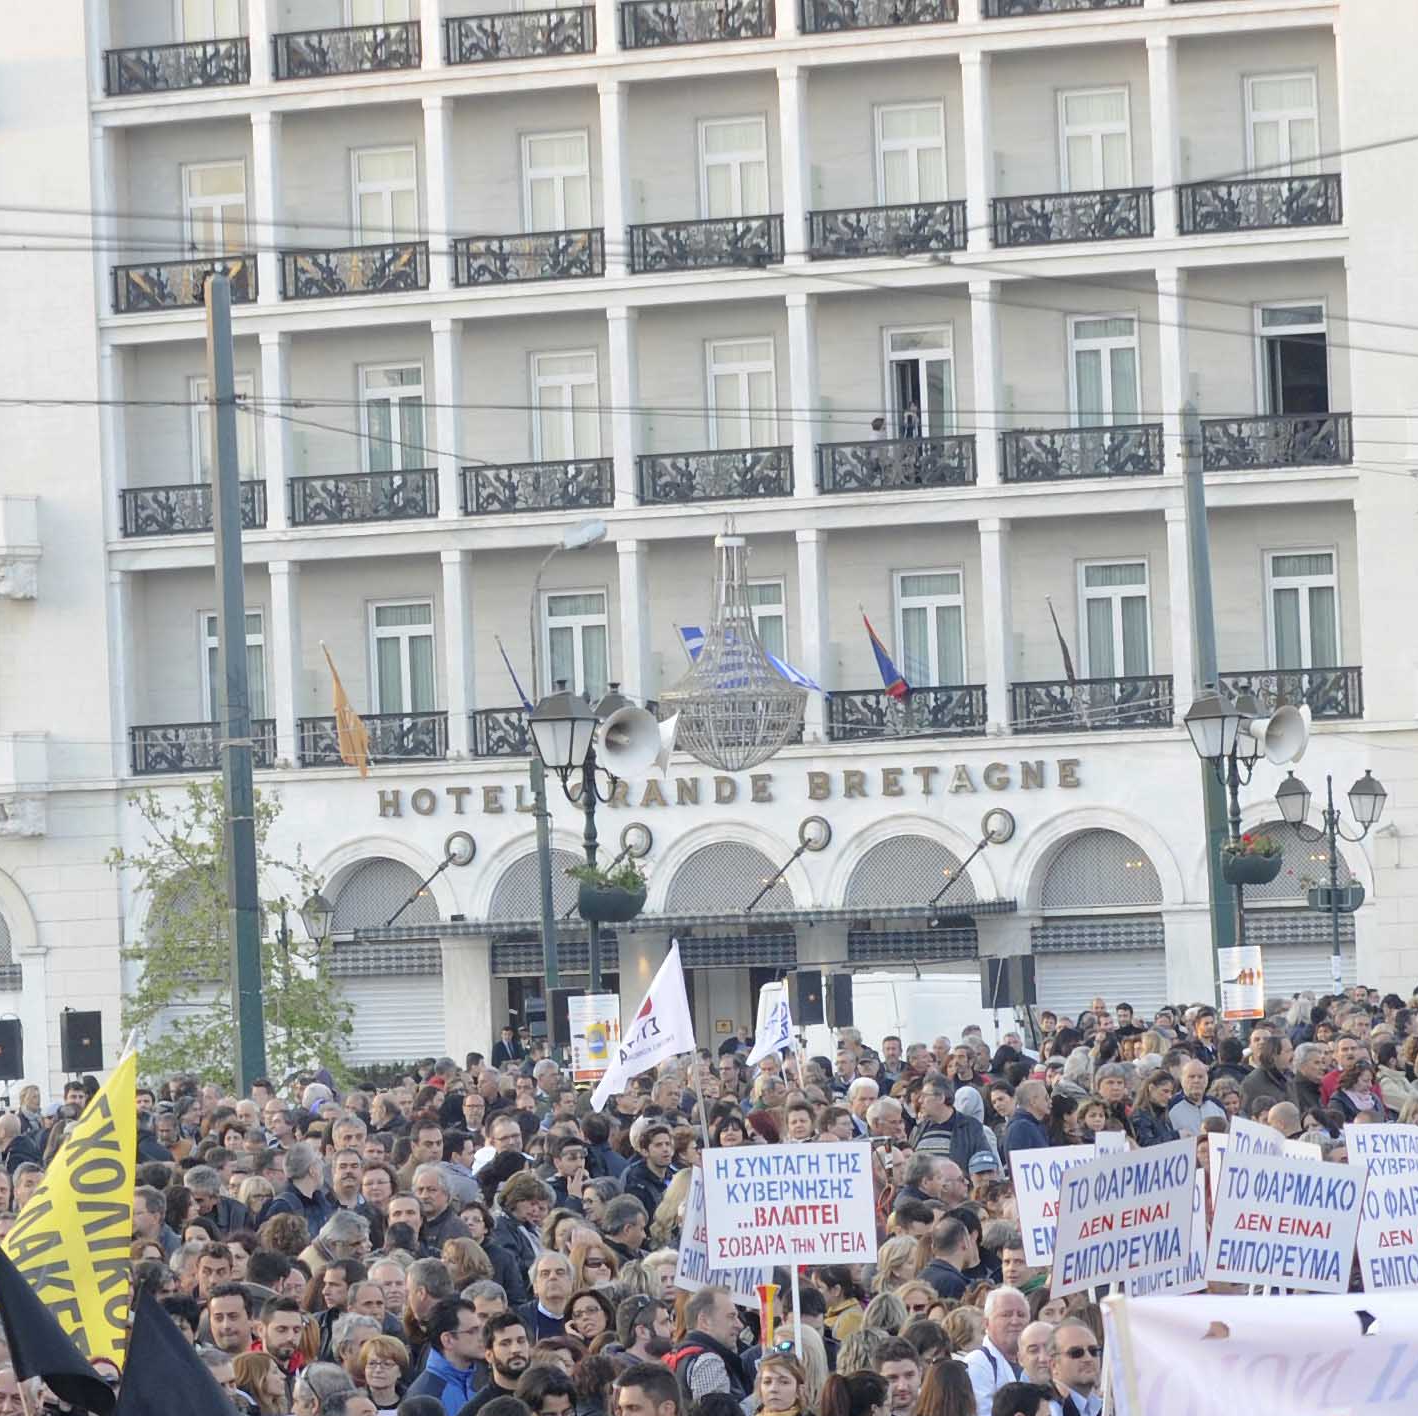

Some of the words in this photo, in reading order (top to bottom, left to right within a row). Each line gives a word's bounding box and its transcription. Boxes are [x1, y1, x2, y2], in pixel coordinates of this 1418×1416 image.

[377, 784, 535, 818] HOTEL
[568, 773, 774, 810] GRANDE
[806, 758, 1081, 801] BRETAGNE
[715, 1158, 729, 1180] Η
[734, 1154, 820, 1179] ΣΥΝΤΑΓΗ
[826, 1152, 862, 1175] ΤΗΣ
[1020, 1161, 1045, 1193] ΤΟ
[725, 1178, 854, 1204] ΚΥΒΕΡΝΗΣΗΣ
[1067, 1178, 1090, 1214] ΤΟ
[1093, 1152, 1190, 1205] ΦΑΡΜΑΚΟ
[1228, 1166, 1250, 1200] ΤΟ
[1253, 1168, 1357, 1212] ΦΑΡΜΑΚΟ
[737, 1204, 839, 1229] ...ΒΛΑΠΤΕΙ
[1078, 1213, 1116, 1241] ΔΕΝ
[1121, 1200, 1171, 1229] ΕΙΝΑΙ
[1234, 1212, 1274, 1233] ΔΕΝ
[1278, 1216, 1332, 1240] ΕΙΝΑΙ
[717, 1233, 787, 1259] ΣΟΒΑΡΑ
[790, 1237, 816, 1255] ΤΗΝ
[820, 1231, 867, 1254] ΥΓΕΙΑ
[1378, 1230, 1414, 1248] ΔΕΝ
[1062, 1226, 1182, 1286] ΕΜΠΟΡΕΥΜΑ
[1216, 1238, 1341, 1283] ΕΜΠΟΡΕΥΜΑ
